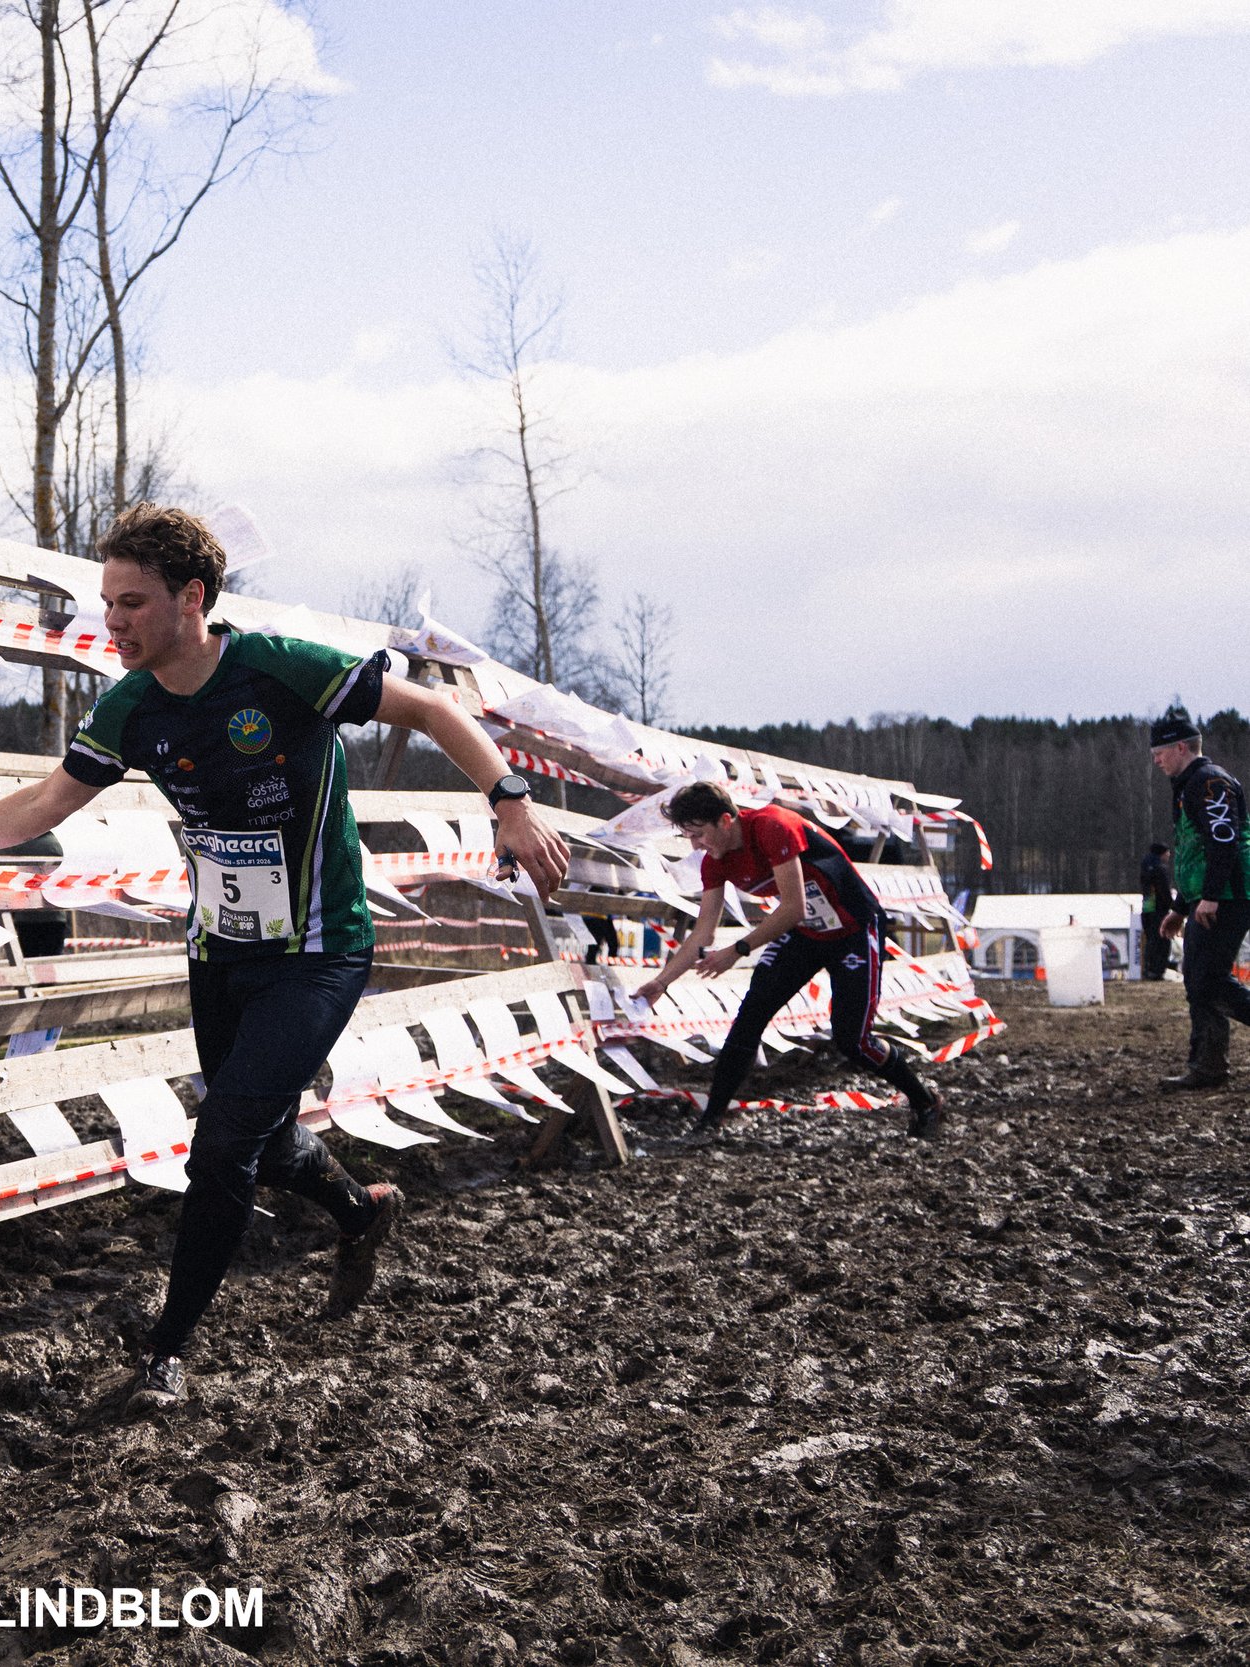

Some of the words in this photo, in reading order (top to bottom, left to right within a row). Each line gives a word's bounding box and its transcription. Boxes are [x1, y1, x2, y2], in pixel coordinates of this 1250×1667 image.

[252, 781, 287, 797] ÖSTRA
[1205, 791, 1235, 842] OKK
[183, 832, 280, 854] bagheera
[221, 872, 241, 904] 5
[270, 871, 282, 884] 3
